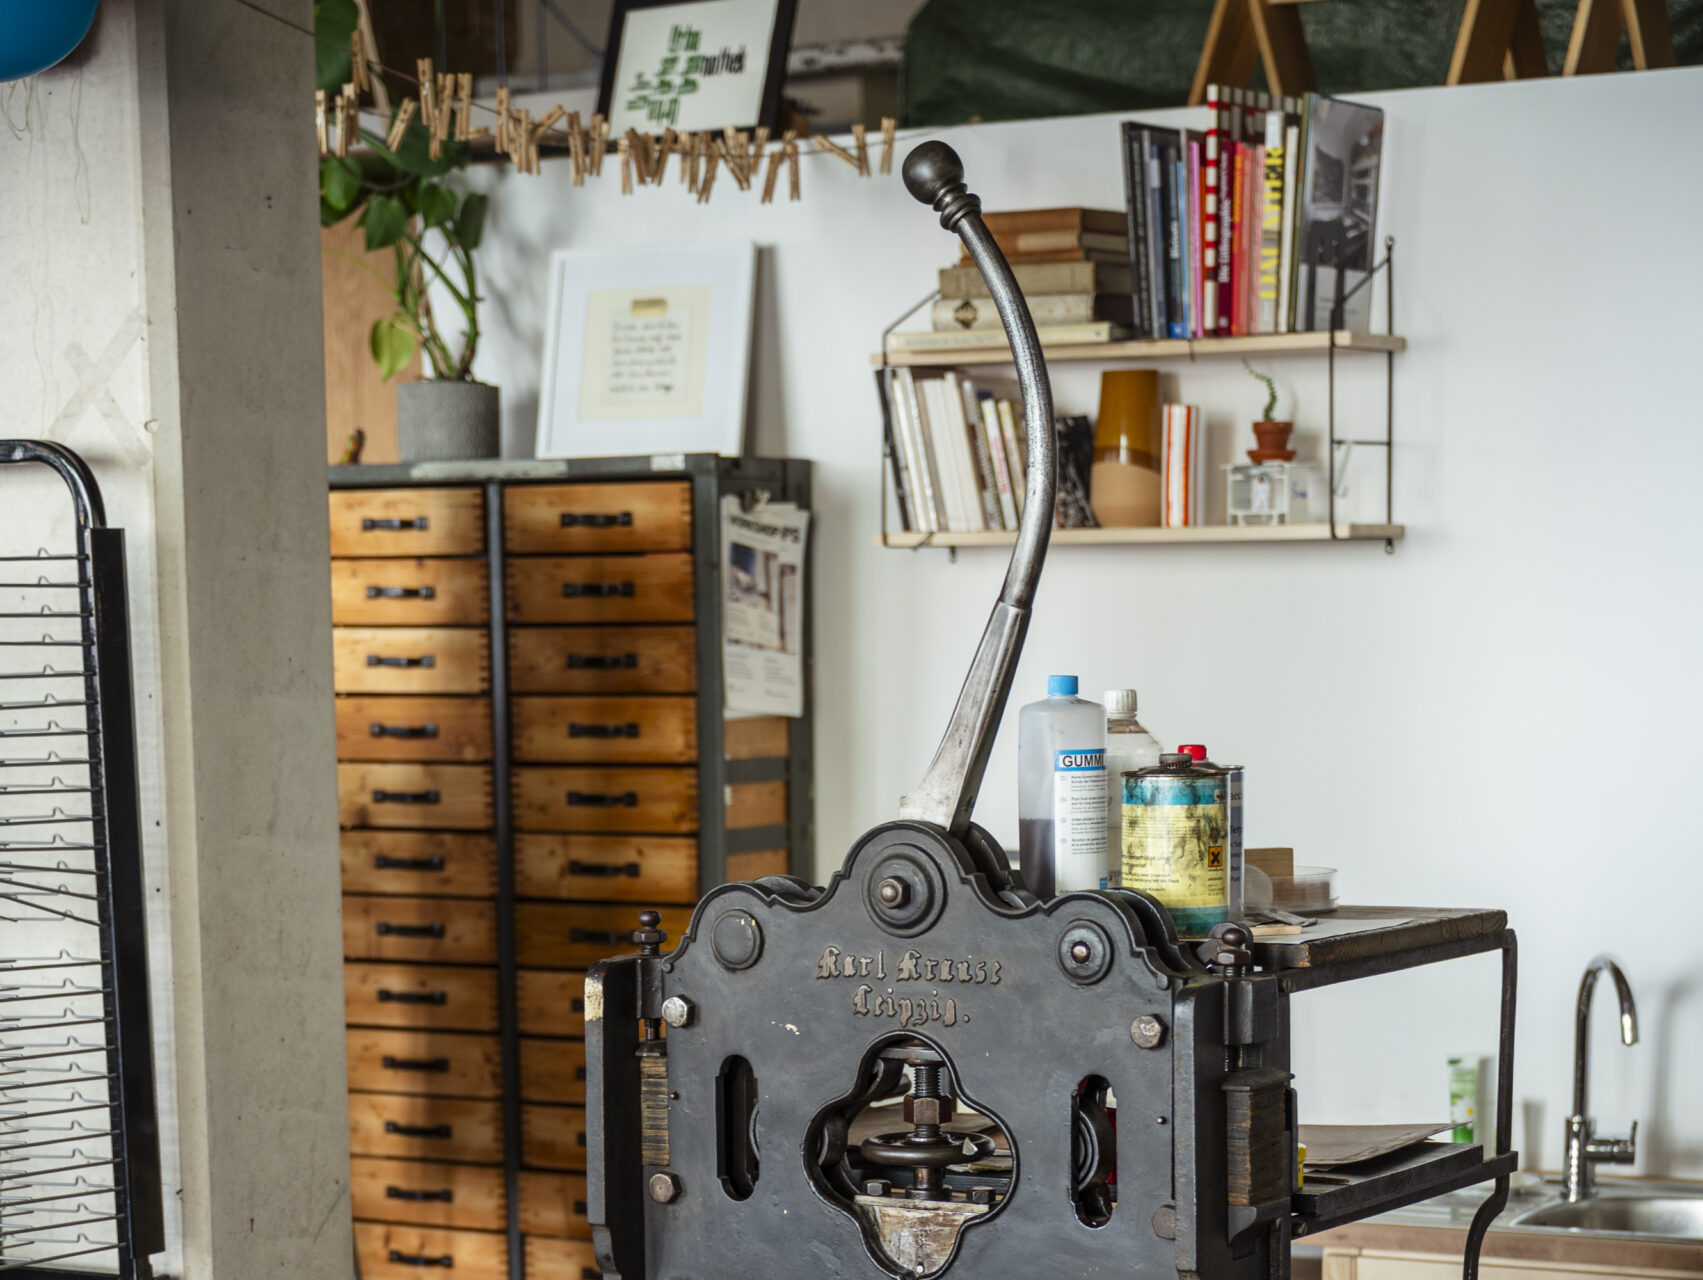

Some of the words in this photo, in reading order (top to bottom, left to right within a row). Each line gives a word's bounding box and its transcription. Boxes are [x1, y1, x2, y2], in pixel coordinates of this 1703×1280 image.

[1062, 754, 1105, 768] GUMMI
[816, 945, 888, 981] Karl
[896, 949, 1002, 986] Krause
[853, 984, 971, 1028] Leipzig.
